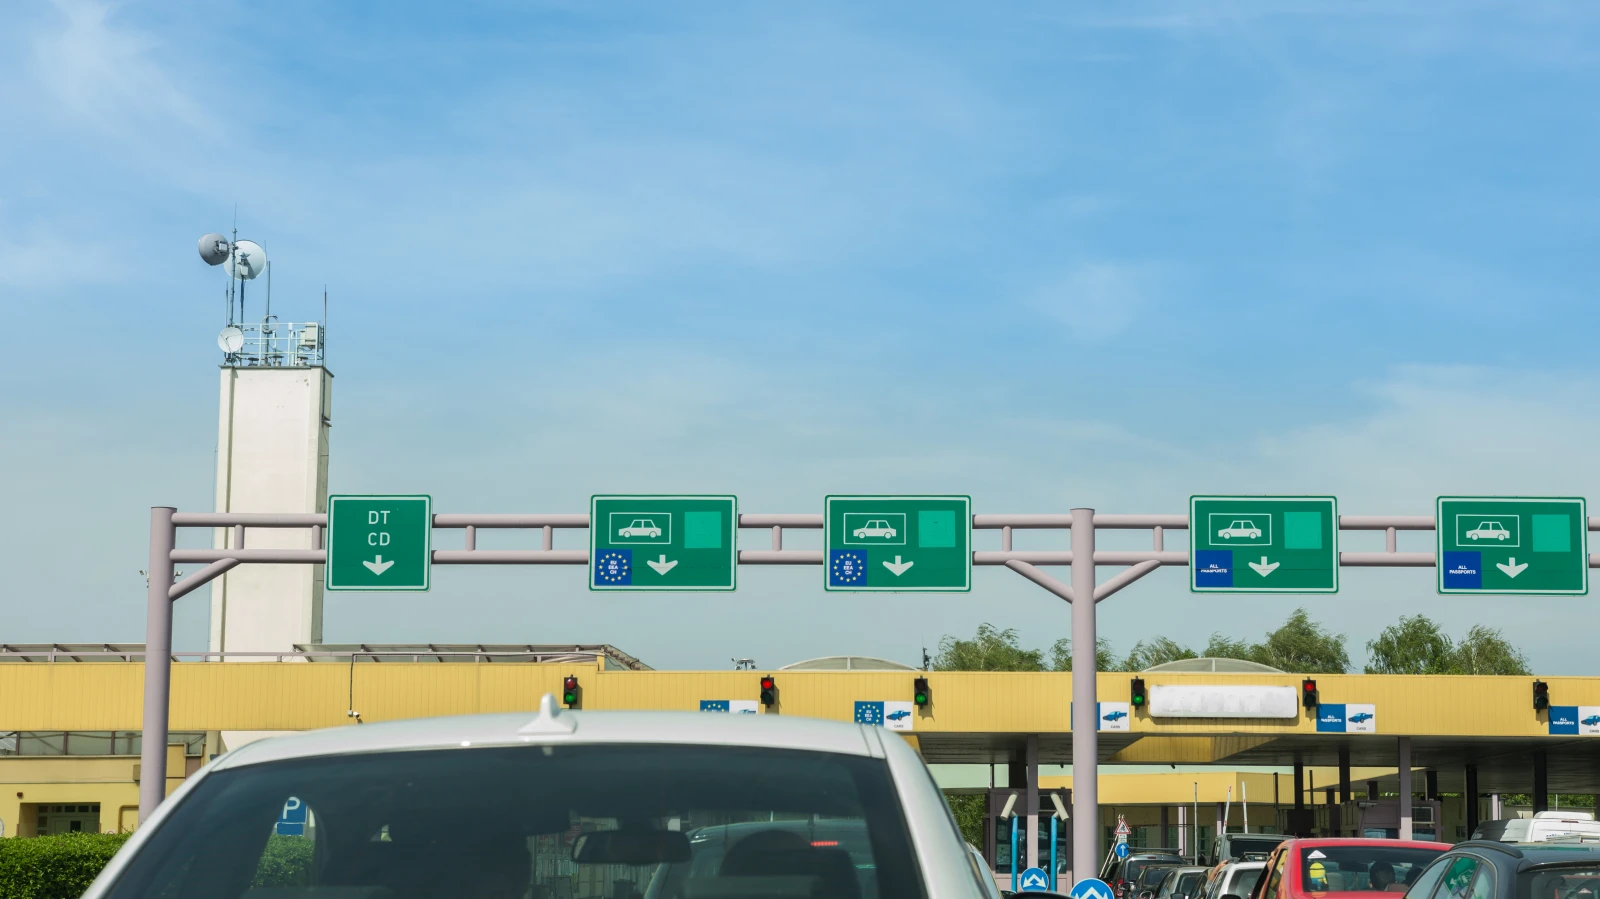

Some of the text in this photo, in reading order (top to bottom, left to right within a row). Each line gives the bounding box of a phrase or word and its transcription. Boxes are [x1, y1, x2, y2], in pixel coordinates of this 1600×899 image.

[368, 510, 391, 525] DT
[367, 532, 391, 546] CD
[282, 796, 301, 820] P
